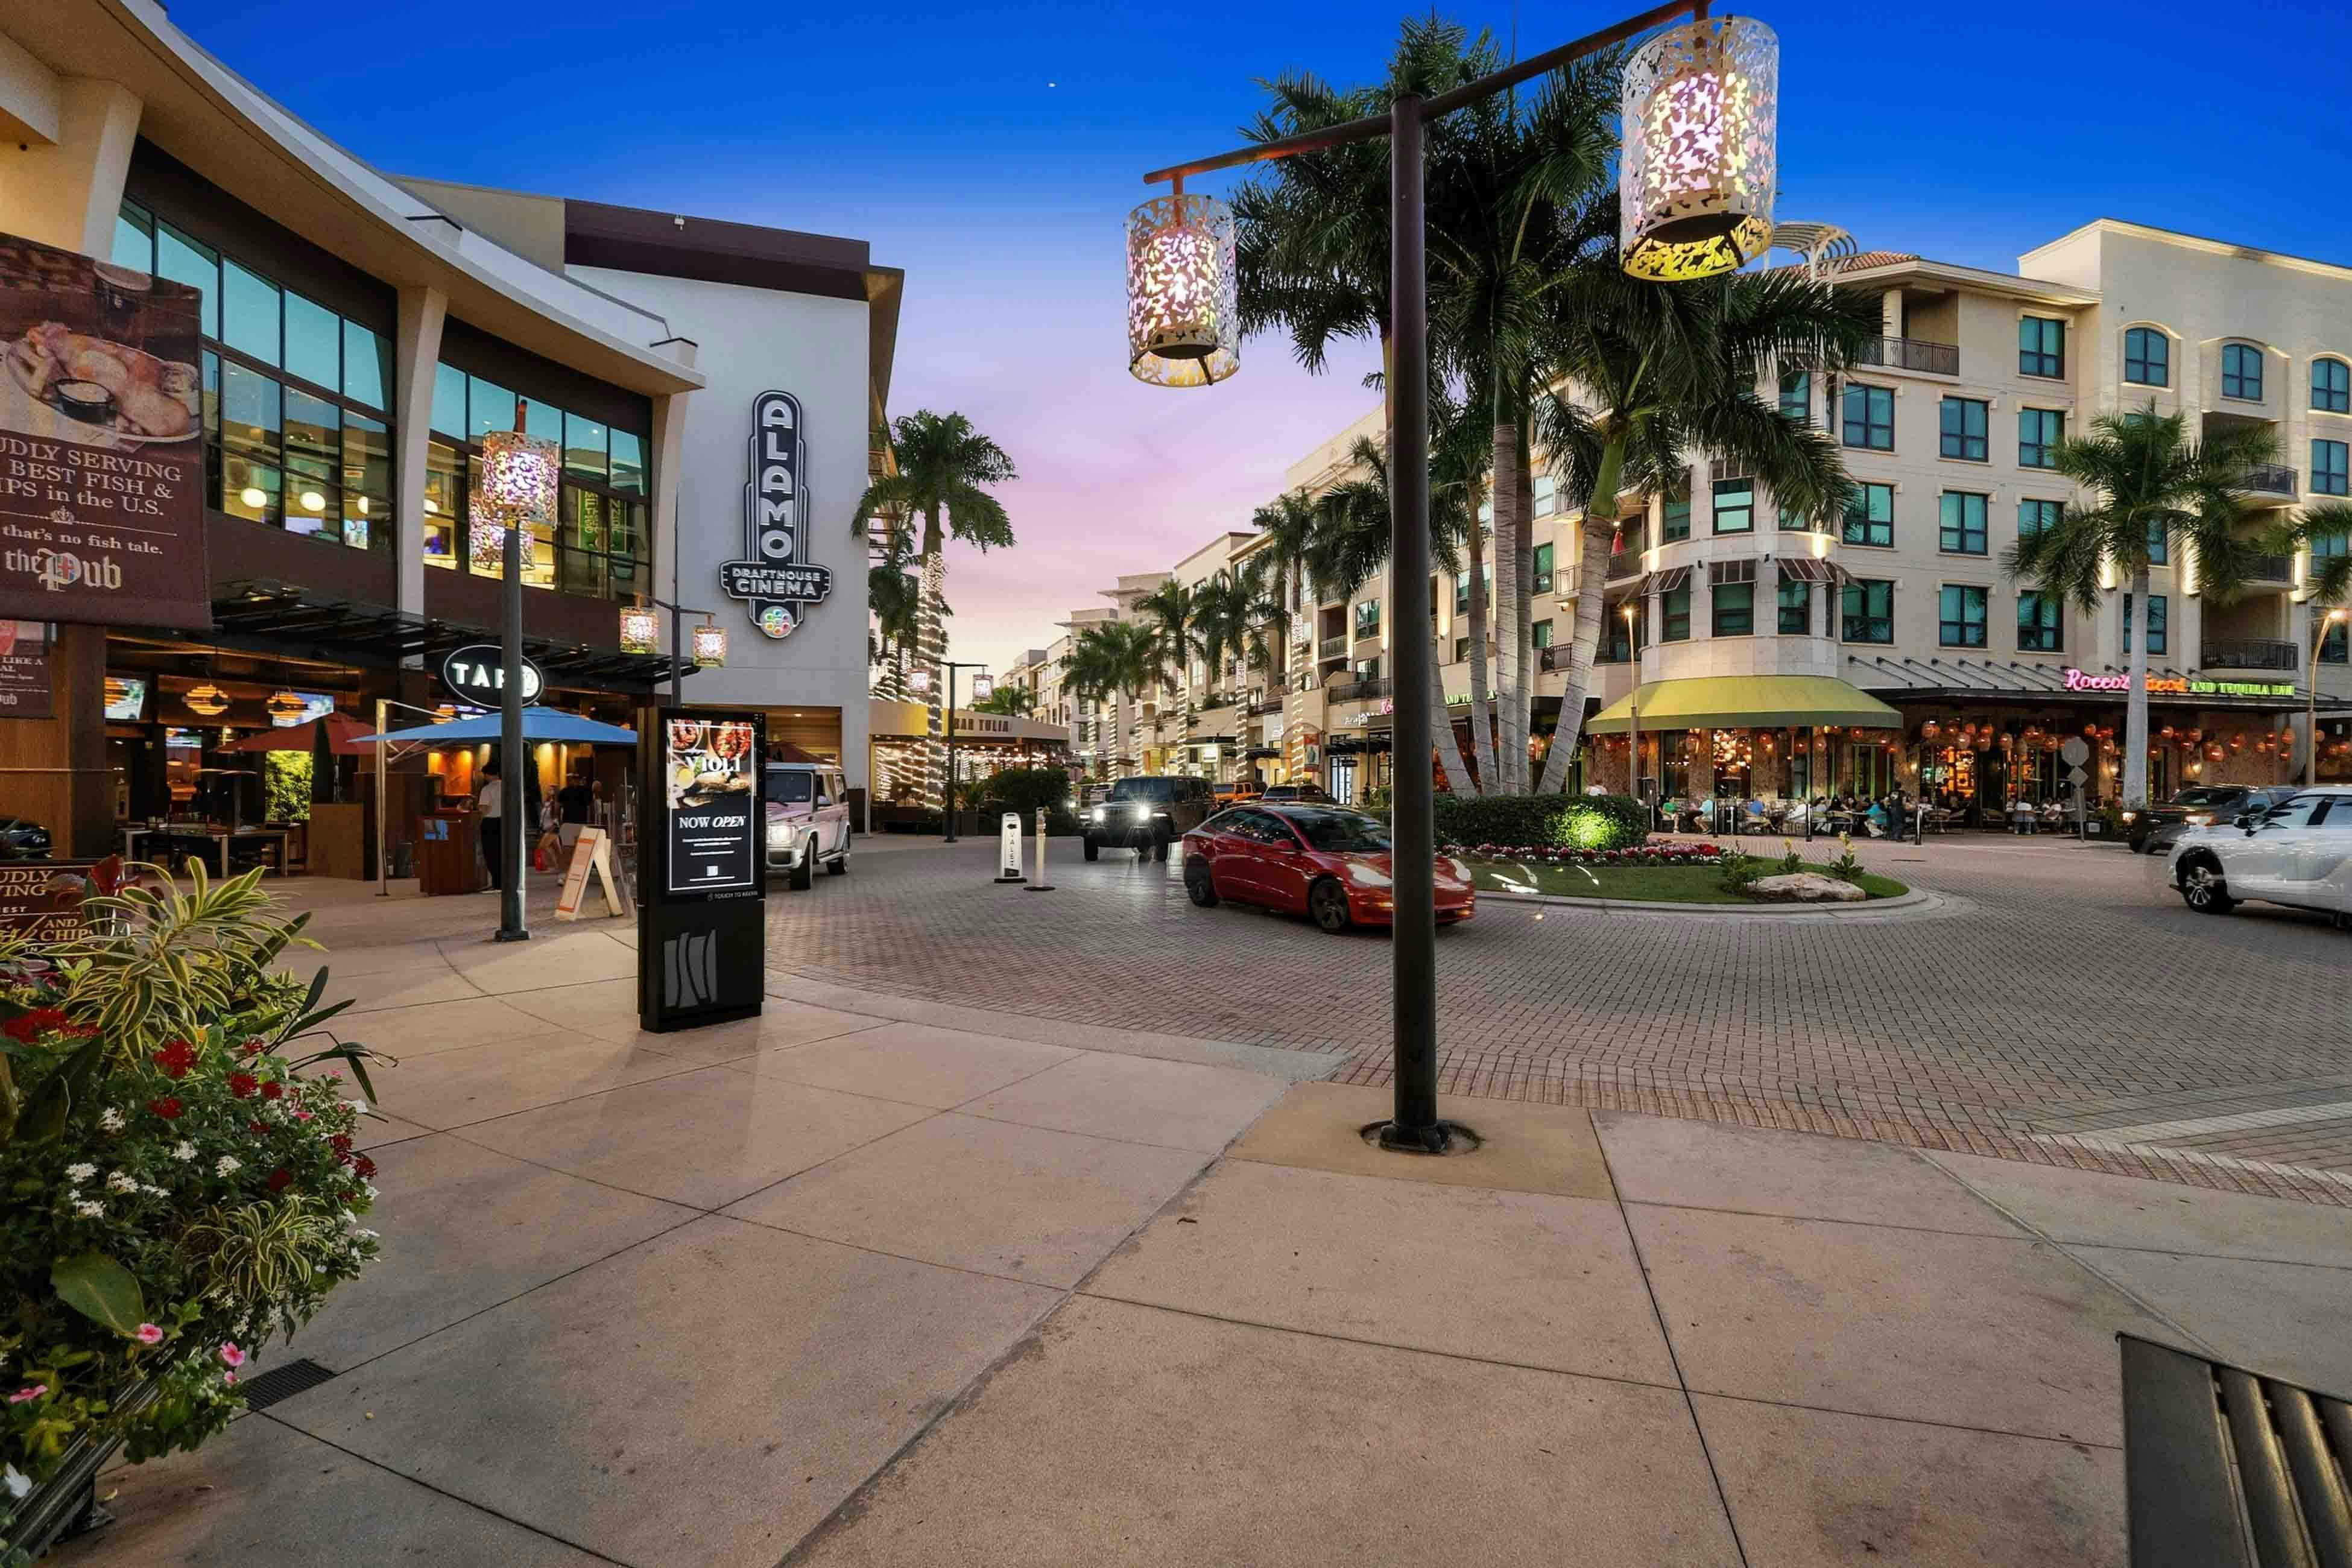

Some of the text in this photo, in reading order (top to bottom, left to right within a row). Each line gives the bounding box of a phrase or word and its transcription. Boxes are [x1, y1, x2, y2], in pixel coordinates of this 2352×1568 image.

[9, 458, 174, 498] BEST FISH &
[67, 449, 182, 481] SERVING
[759, 399, 794, 558] ALAMO
[47, 485, 69, 502] in
[77, 490, 113, 508] the
[121, 496, 164, 516] U.S.
[2, 524, 163, 554] that's no fish tale.
[5, 548, 121, 592] the Pub
[732, 567, 821, 581] DRAFTHOUSE
[735, 578, 816, 596] CINEMA
[2, 656, 32, 665] LIKE
[679, 816, 746, 829] NOW OPEN
[45, 918, 78, 928] AND
